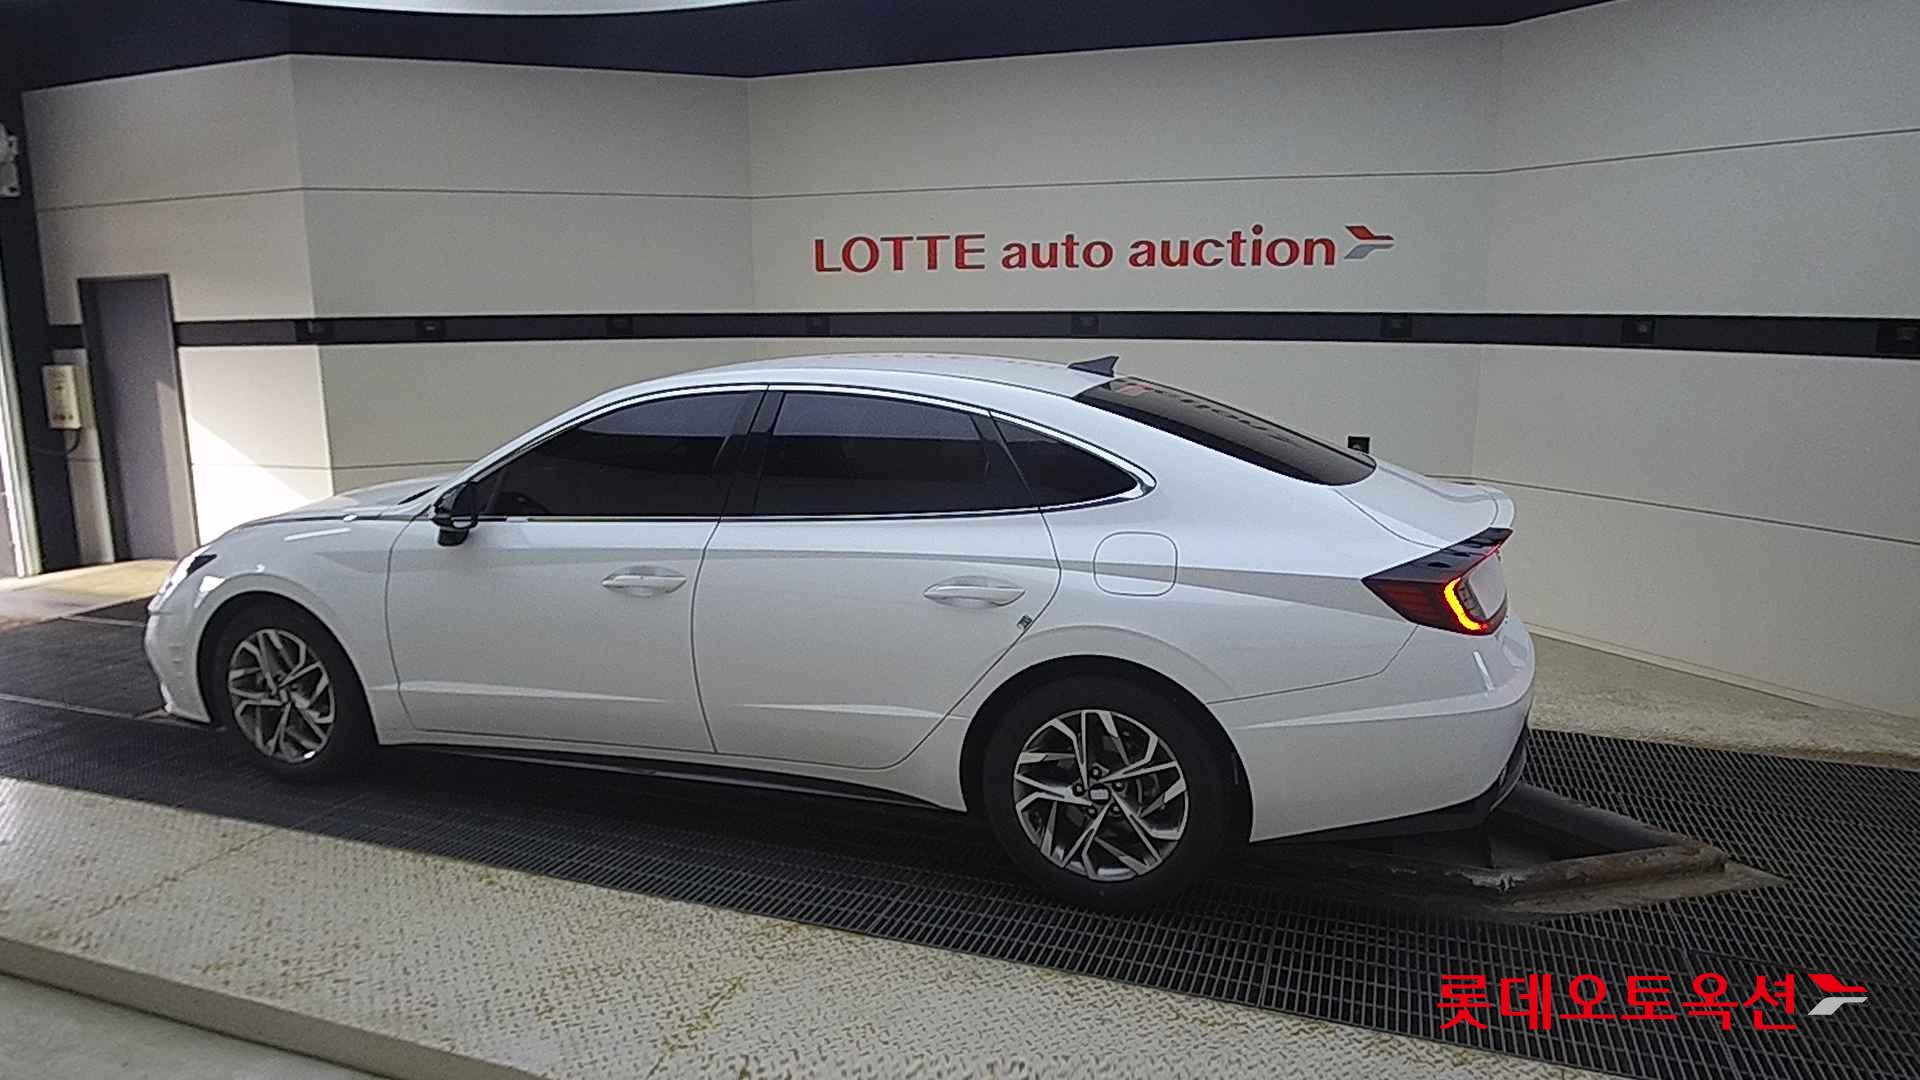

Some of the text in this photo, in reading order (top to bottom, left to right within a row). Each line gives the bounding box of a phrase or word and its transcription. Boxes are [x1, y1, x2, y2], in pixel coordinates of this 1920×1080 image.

[815, 224, 1336, 273] LOTTE auto auction
